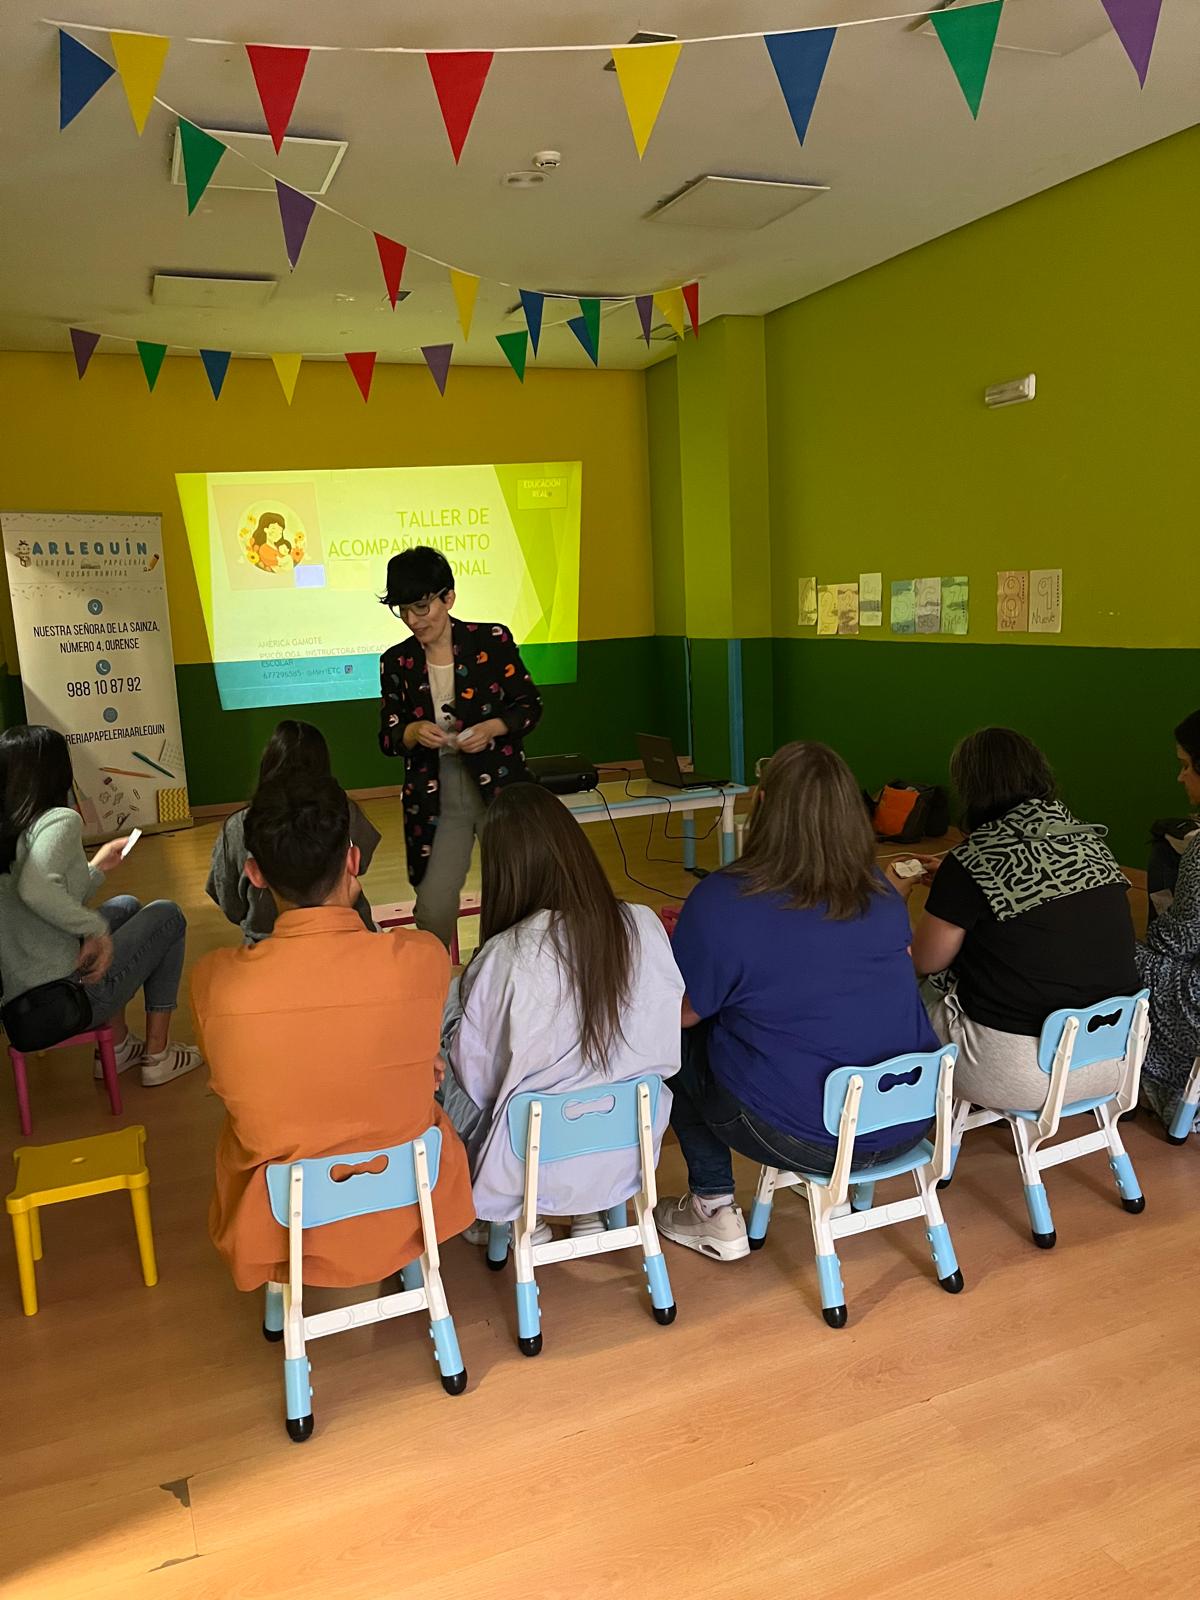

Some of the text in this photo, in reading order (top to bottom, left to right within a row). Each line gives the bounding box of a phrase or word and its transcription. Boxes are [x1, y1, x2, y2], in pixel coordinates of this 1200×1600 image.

[396, 507, 490, 528] TALLER DE
[32, 537, 148, 556] ARLEQUÍN
[328, 534, 490, 558] ACOMPAÑAMIENTO
[33, 624, 72, 637] NUESTRA
[73, 622, 107, 636] SEÑORA
[106, 622, 117, 635] DE
[118, 622, 129, 633] LA
[60, 639, 95, 653] NÚMERO
[105, 638, 140, 651] OURENSE
[67, 677, 142, 697] 988 10 87 92
[65, 724, 165, 745] RERIAPAPELERIAARLEQUIN
